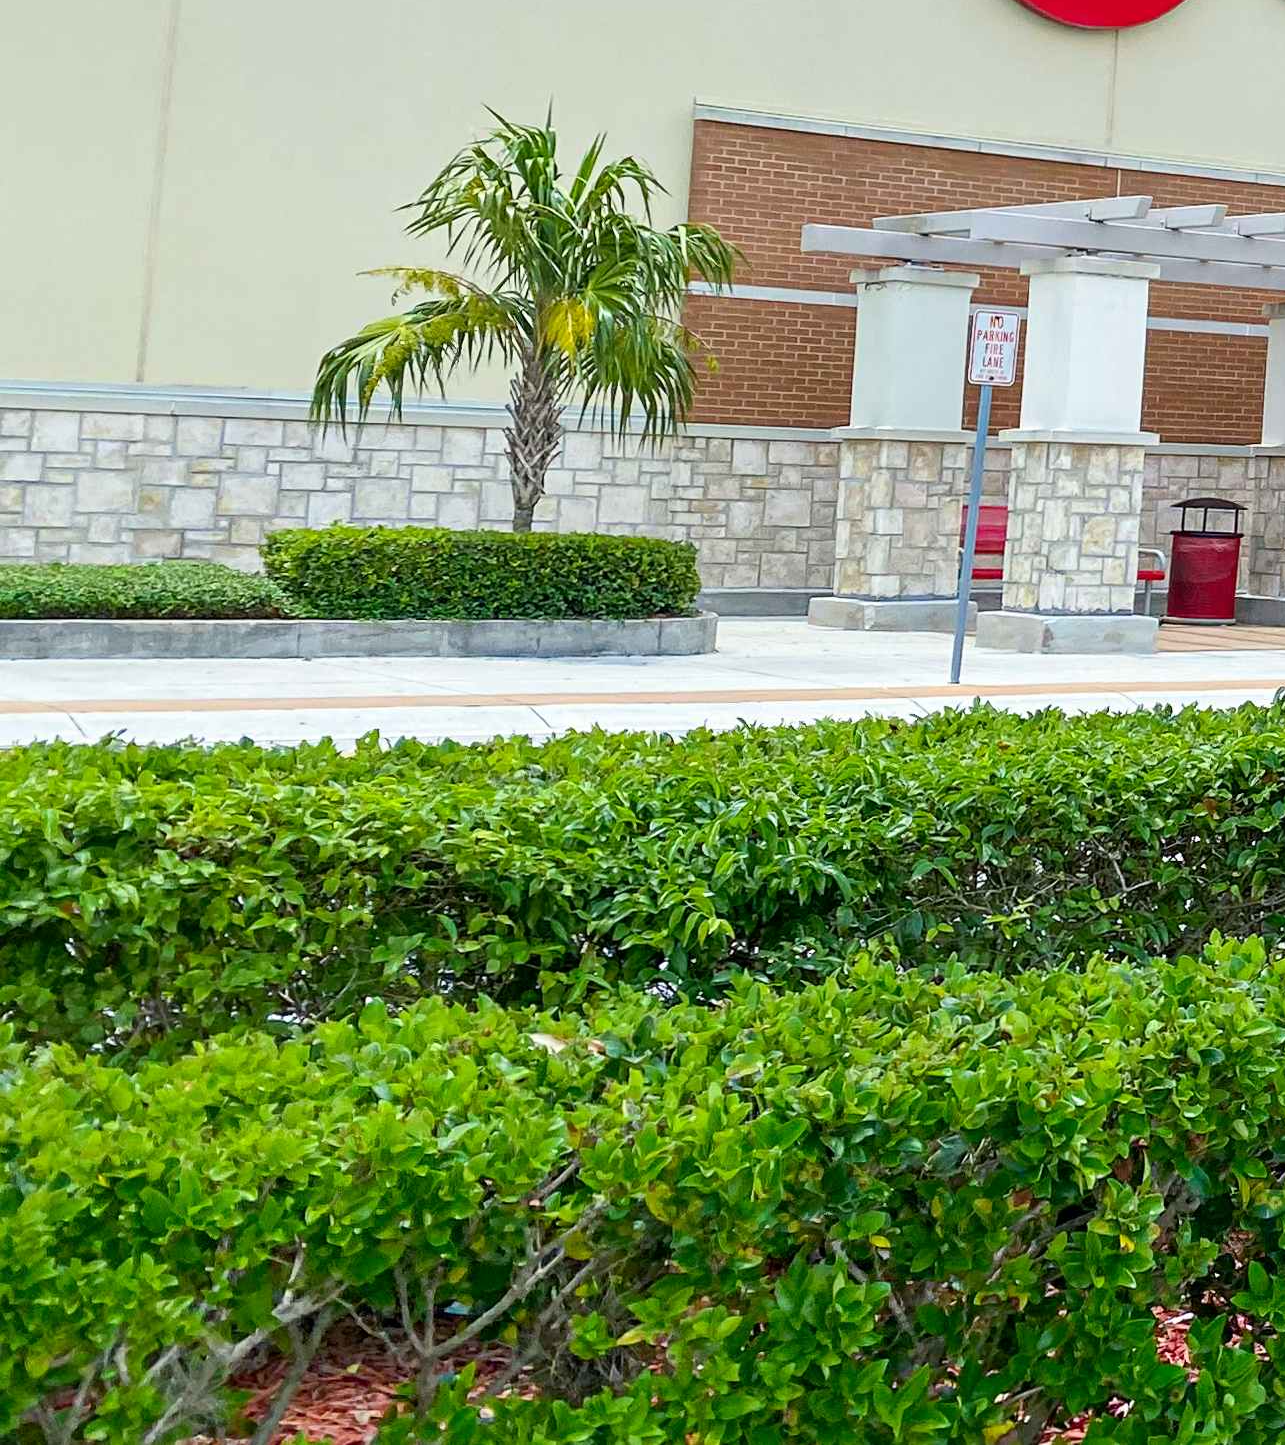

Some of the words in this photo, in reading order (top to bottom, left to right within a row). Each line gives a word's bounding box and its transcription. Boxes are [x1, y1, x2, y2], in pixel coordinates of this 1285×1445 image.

[977, 329, 1015, 343] PARKING
[985, 342, 1004, 356] FIRE
[982, 355, 1005, 369] LANE
